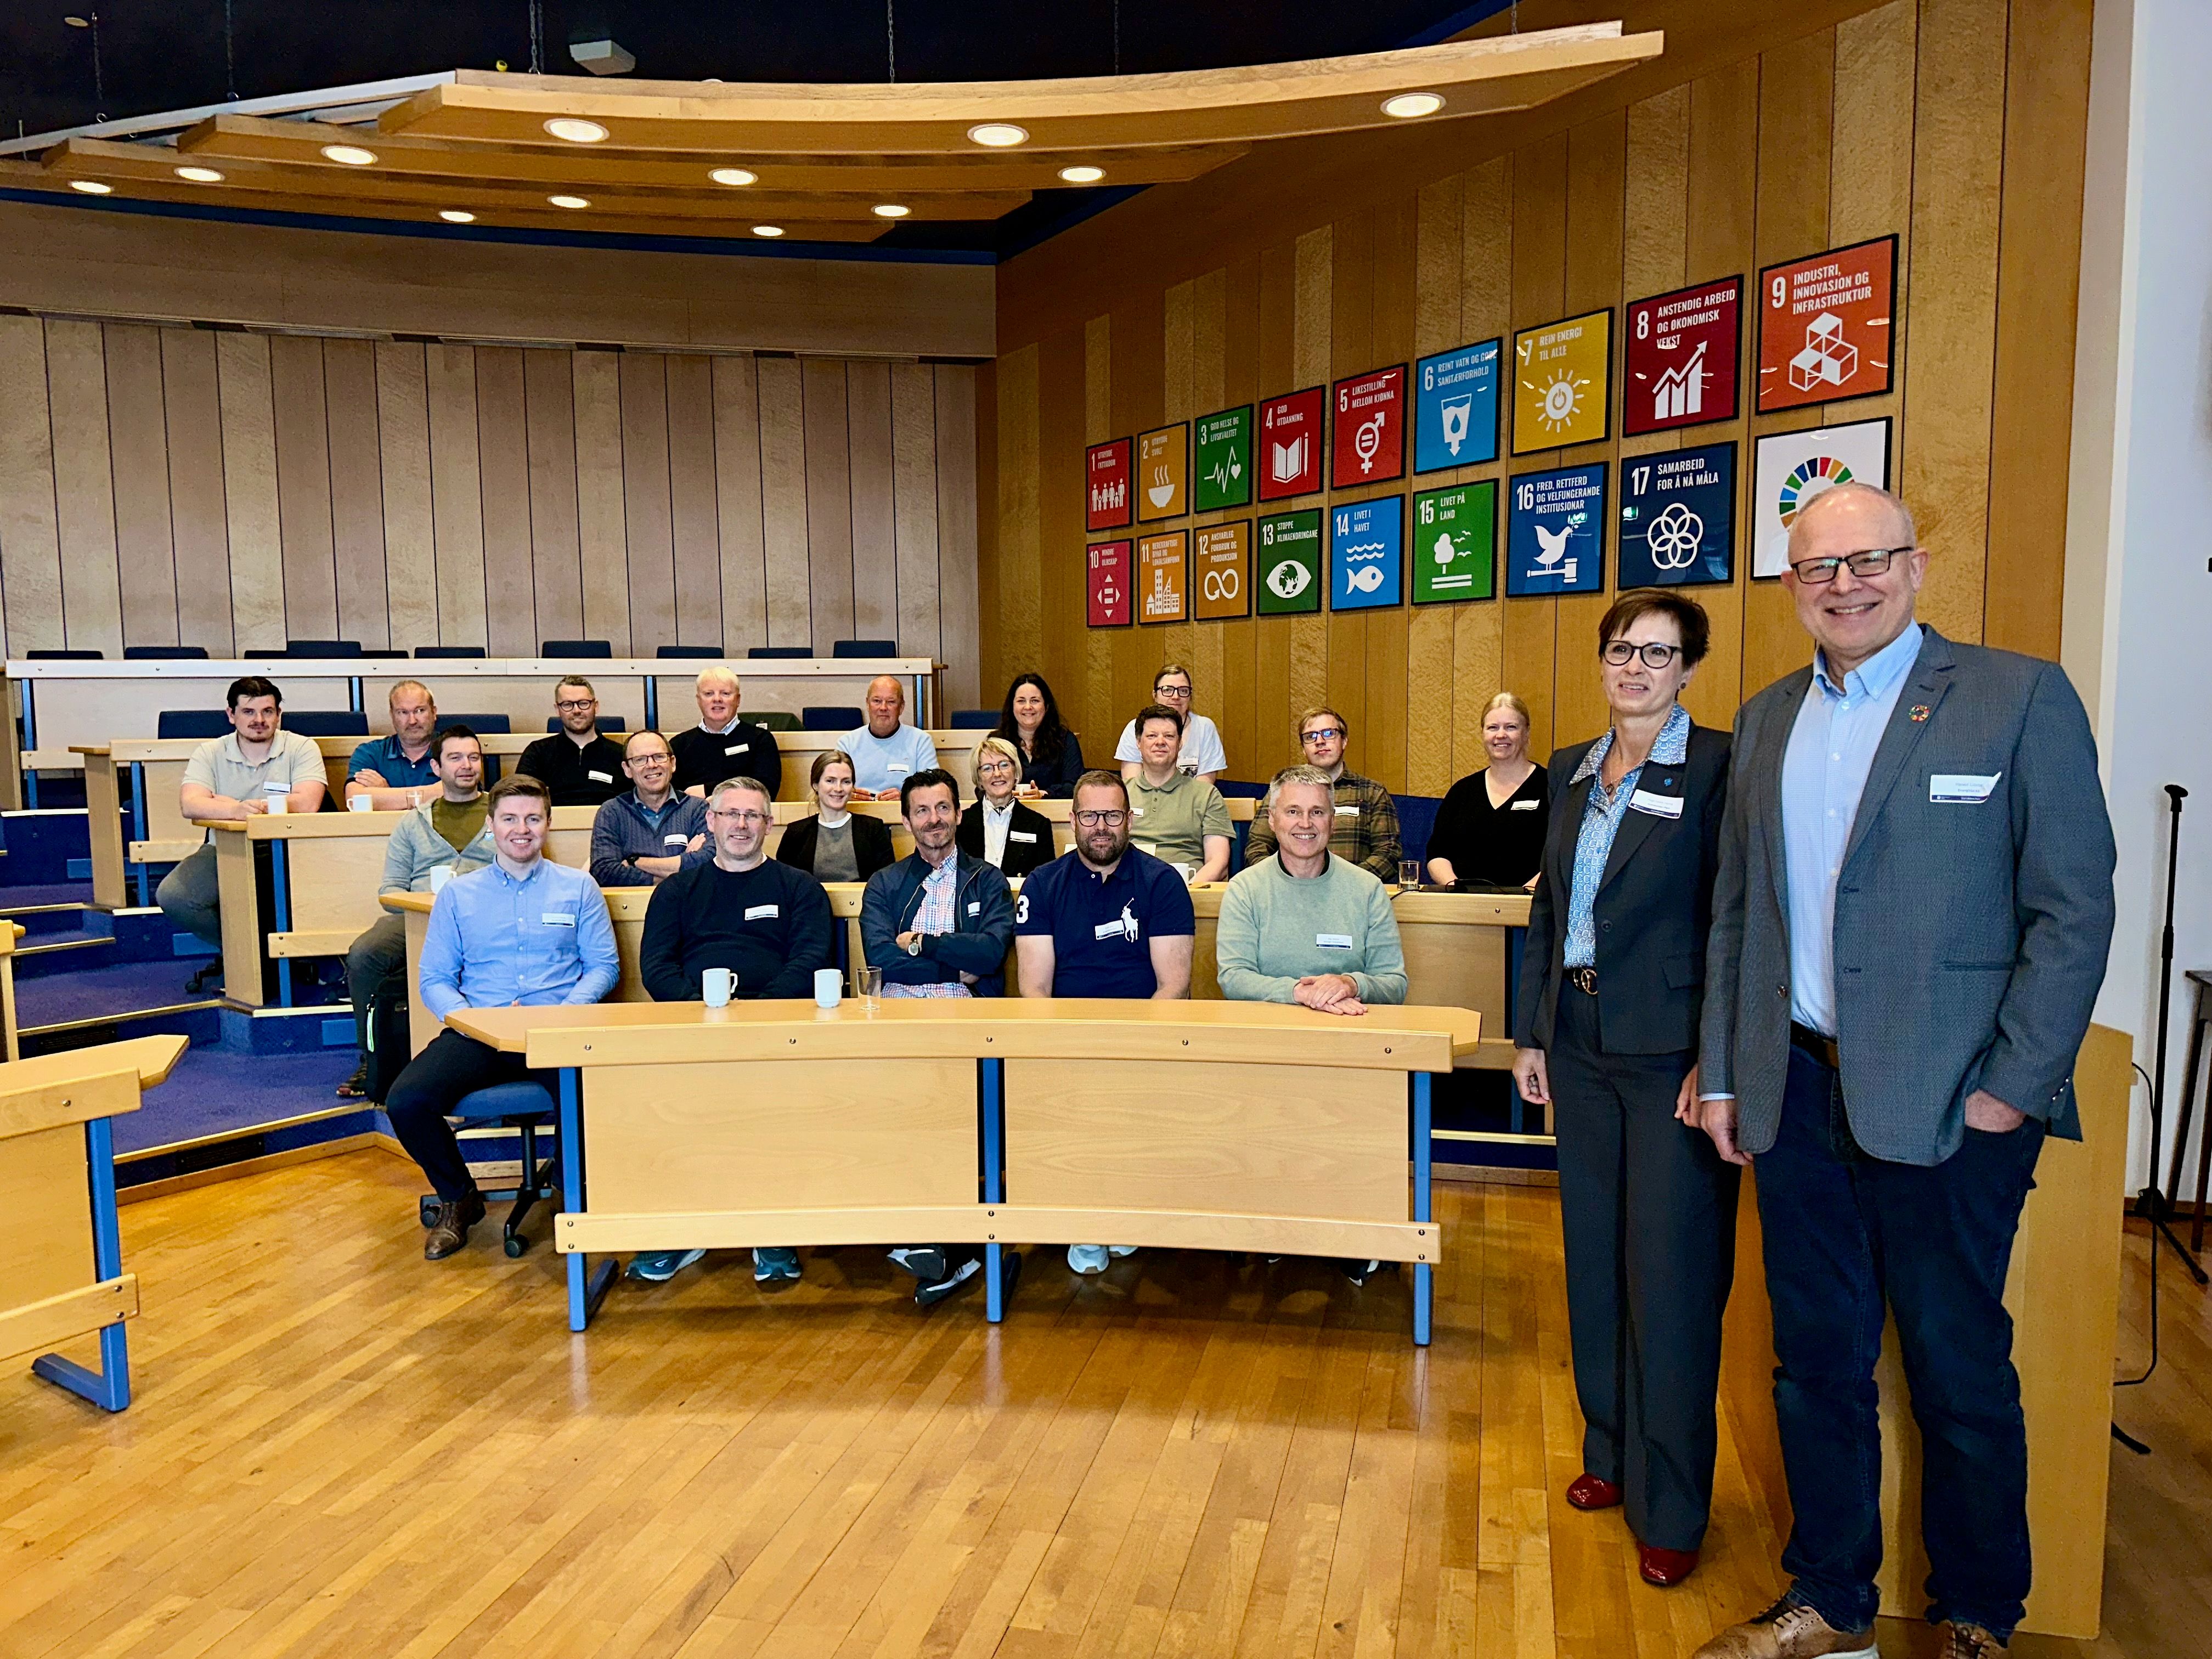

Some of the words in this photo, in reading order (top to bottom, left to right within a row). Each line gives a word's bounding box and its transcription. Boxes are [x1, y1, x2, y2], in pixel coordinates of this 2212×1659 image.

[1794, 264, 1841, 285] INDUSTRI,
[1772, 276, 1786, 308] 9
[1793, 275, 1852, 300] INNOVASJON
[1855, 272, 1869, 285] OG
[1657, 297, 1702, 318] ANSTENDIG
[1704, 289, 1735, 307] ARBEID
[1793, 286, 1872, 315] INFRASTRUKTUR
[1637, 311, 1649, 340] 8
[1657, 323, 1668, 334] OG
[1671, 309, 1720, 331] ØKONOMISK
[1539, 334, 1556, 346] REIN
[1558, 326, 1582, 342] ENERGI
[1656, 334, 1681, 348] VEKST
[1524, 339, 1533, 366] 7
[1539, 349, 1549, 361] TIL
[1551, 345, 1567, 358] ALLE
[1438, 361, 1454, 373] REINT
[1455, 357, 1469, 369] VATN
[1471, 354, 1479, 364] OG
[1425, 366, 1434, 391] 6
[1437, 365, 1489, 386] SANITÆRFORHOLD
[1352, 380, 1386, 396] LIKESTILLING
[1340, 388, 1348, 412] 5
[1352, 395, 1373, 408] MELLOM
[1266, 408, 1273, 429] 4
[1277, 412, 1304, 426] UTDANNING
[1201, 425, 1207, 445] 3
[1143, 440, 1148, 459] 2
[1092, 453, 1095, 471] 1
[1657, 458, 1705, 475] SAMARBEID
[1537, 481, 1555, 492] FRED,
[1556, 476, 1588, 489] RETTFERD
[1632, 466, 1650, 495] 17
[1657, 478, 1673, 490] FOR
[1675, 475, 1680, 488] Å
[1683, 473, 1694, 487] NÅ
[1696, 470, 1719, 486] MÅLA
[1440, 496, 1456, 507] LIVET
[1457, 492, 1465, 504] PÅ
[1517, 483, 1534, 510] 16
[1537, 494, 1545, 503] OG
[1547, 486, 1600, 501] VELFUNGERANDE
[1354, 509, 1368, 520] LIVET
[1368, 509, 1371, 518] I
[1420, 499, 1434, 524] 15
[1440, 510, 1455, 520] LAND
[1536, 499, 1584, 515] INSTITUSJONAR
[1262, 524, 1274, 545] 13
[1277, 521, 1294, 531] STOPPE
[1336, 513, 1348, 537] 14
[1354, 522, 1370, 533] HAVET
[1199, 534, 1208, 555] 12
[1231, 541, 1237, 549] OG
[1277, 529, 1318, 543] KLIMAENDRINGANE
[1090, 550, 1099, 569] 10
[1142, 544, 1149, 562] 11
[1016, 895, 1029, 923] 3
